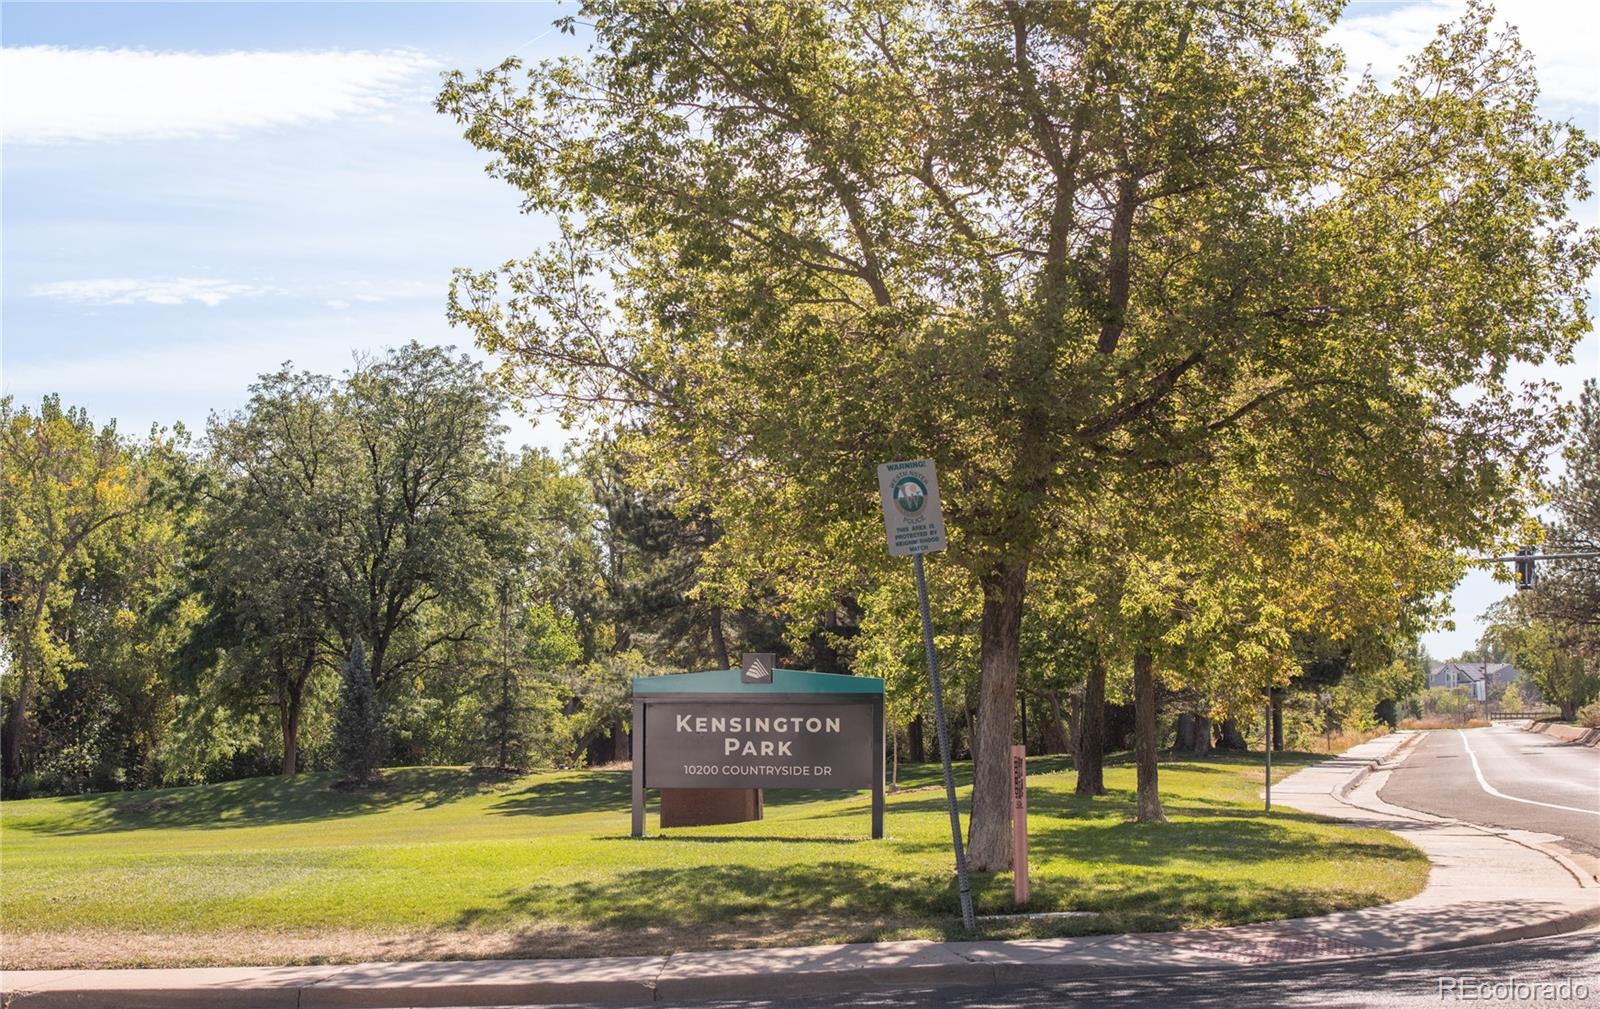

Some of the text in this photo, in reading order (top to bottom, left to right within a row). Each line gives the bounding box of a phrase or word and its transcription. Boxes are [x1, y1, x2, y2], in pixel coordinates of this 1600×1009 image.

[911, 524, 927, 532] AREA
[895, 531, 928, 540] PROTECTED
[684, 765, 832, 776] 10200 COUNTRYSIDE DR
